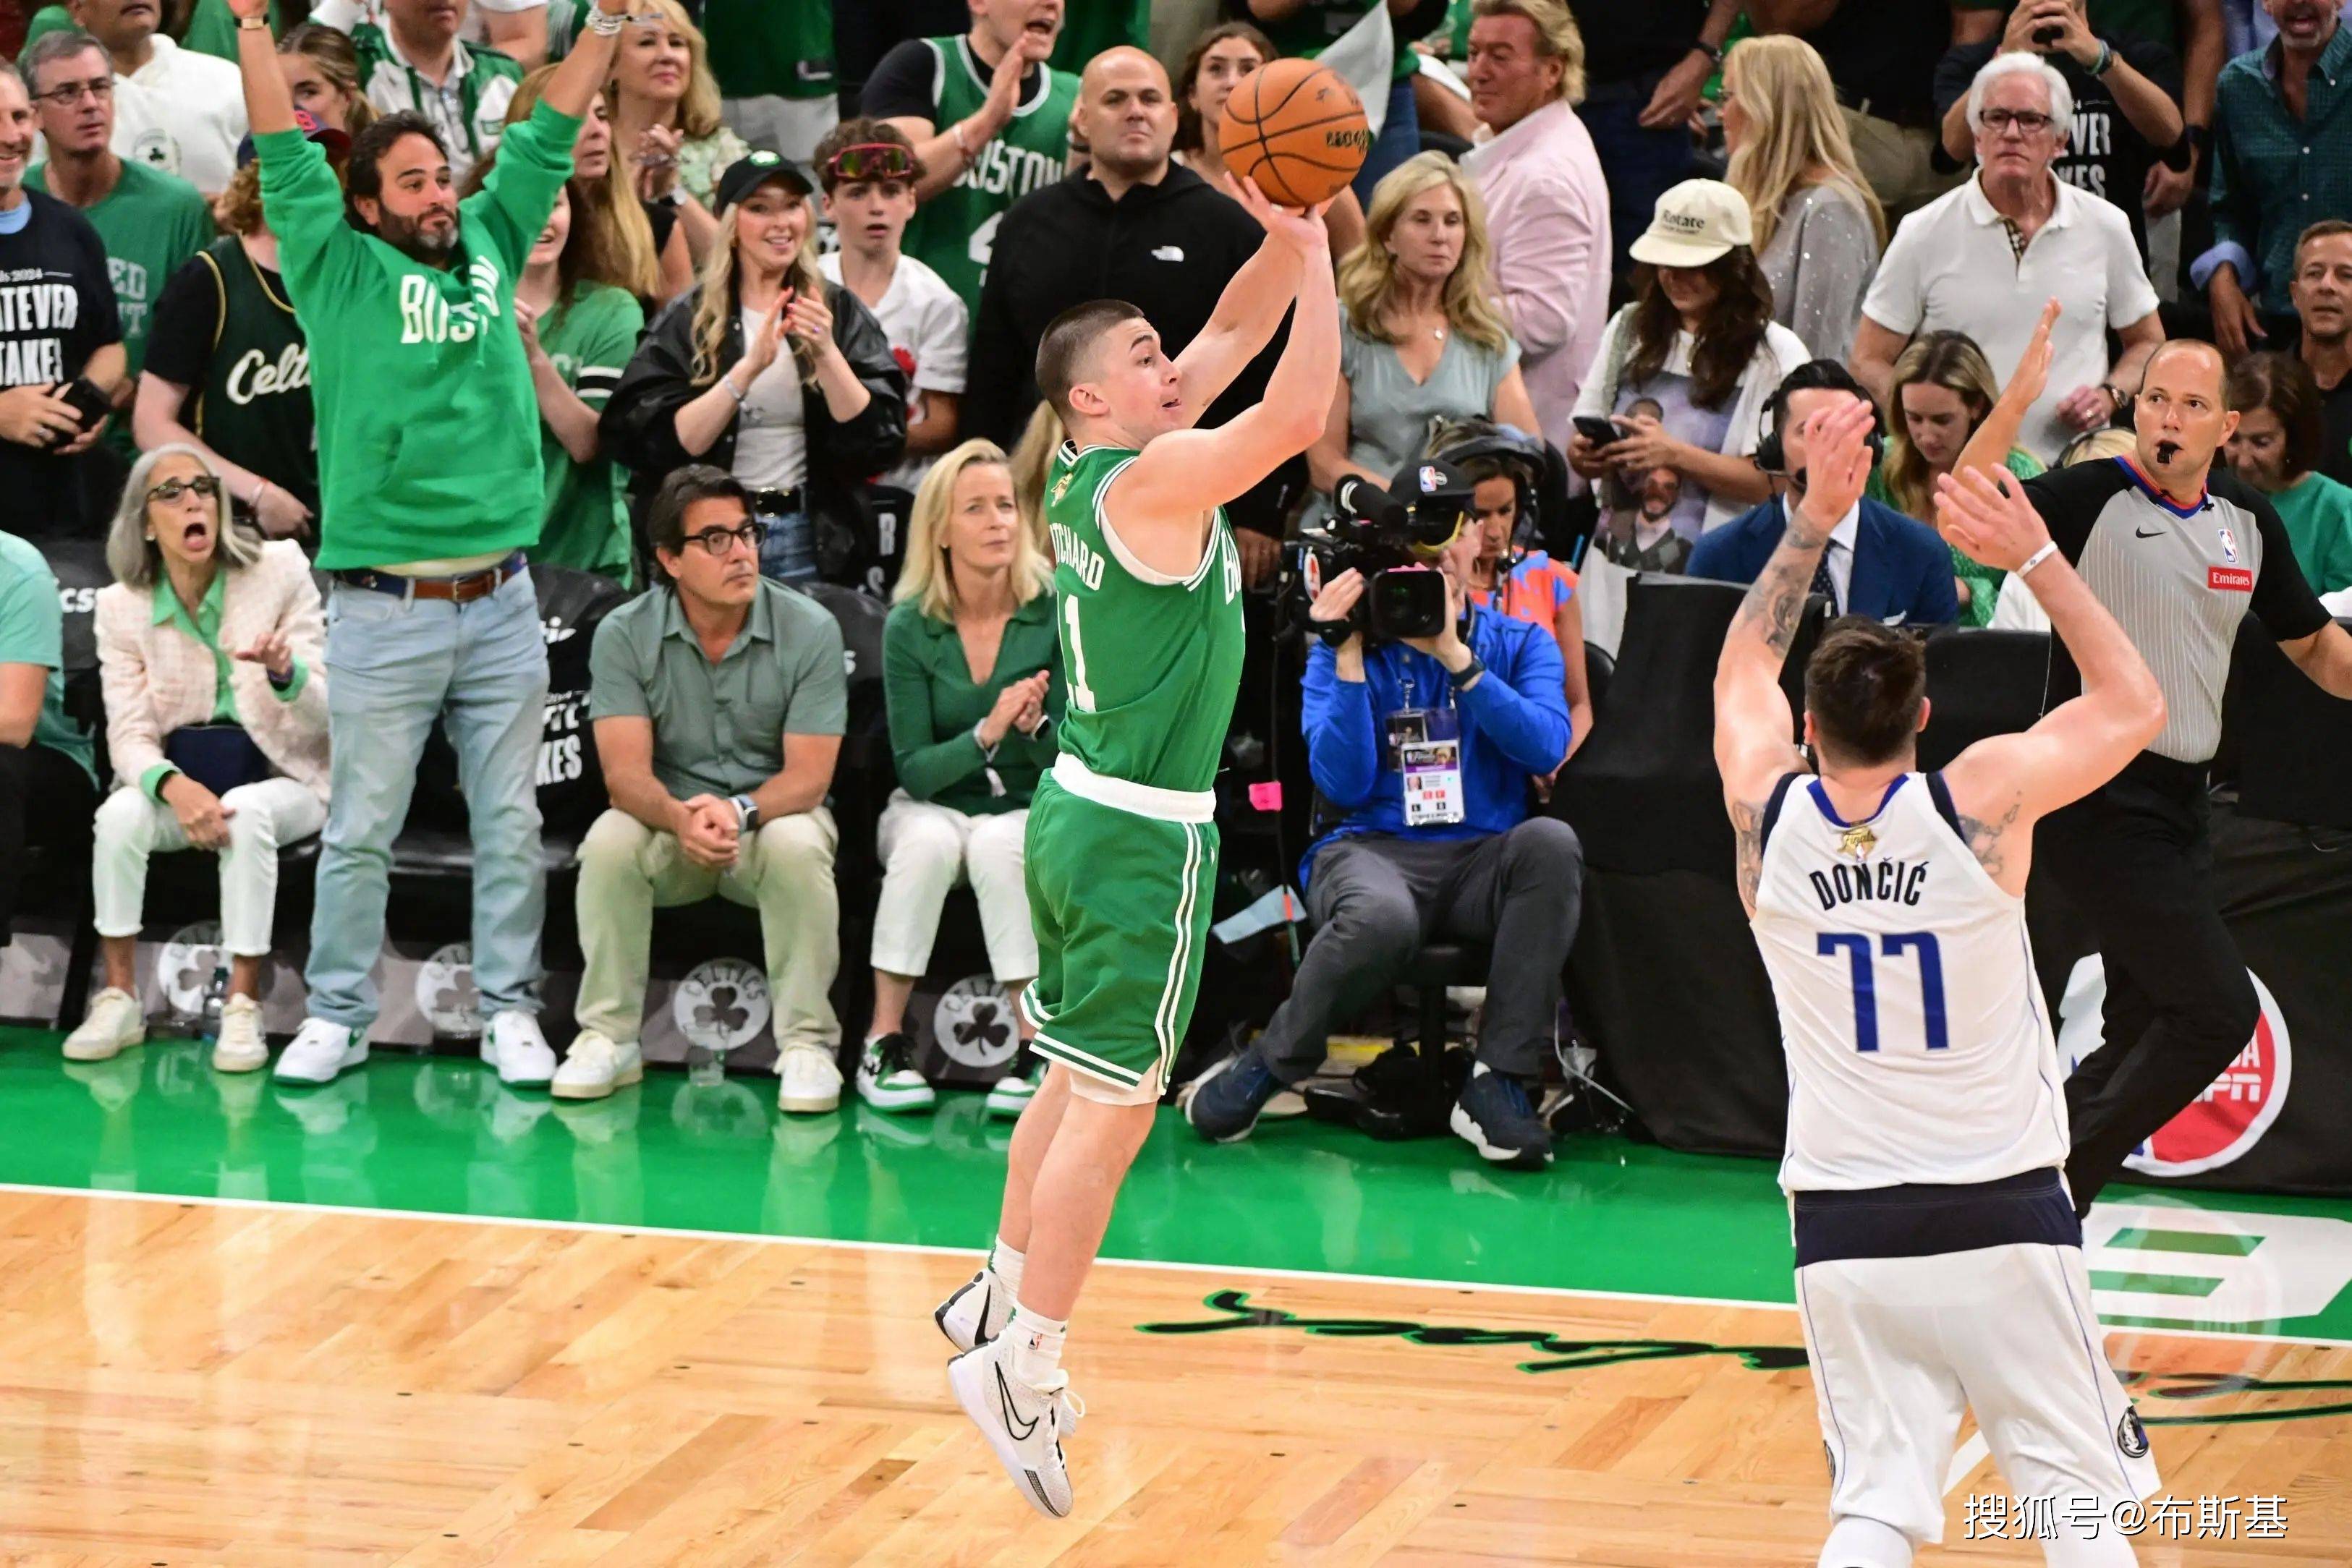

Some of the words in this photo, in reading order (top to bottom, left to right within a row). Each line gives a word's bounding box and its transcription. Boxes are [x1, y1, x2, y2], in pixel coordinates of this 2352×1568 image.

[953, 139, 1063, 195] OSTON
[1663, 209, 1705, 229] Rotate
[0, 283, 78, 333] TEVER
[400, 255, 501, 344] BOS
[226, 342, 311, 405] Celt
[2212, 571, 2250, 586] Emirates
[1057, 593, 1096, 712] 1
[1809, 856, 1929, 911] DONČIĆ
[685, 963, 767, 1000] CELTICS
[943, 976, 1015, 1017] CELTI
[1817, 931, 1949, 1052] 77
